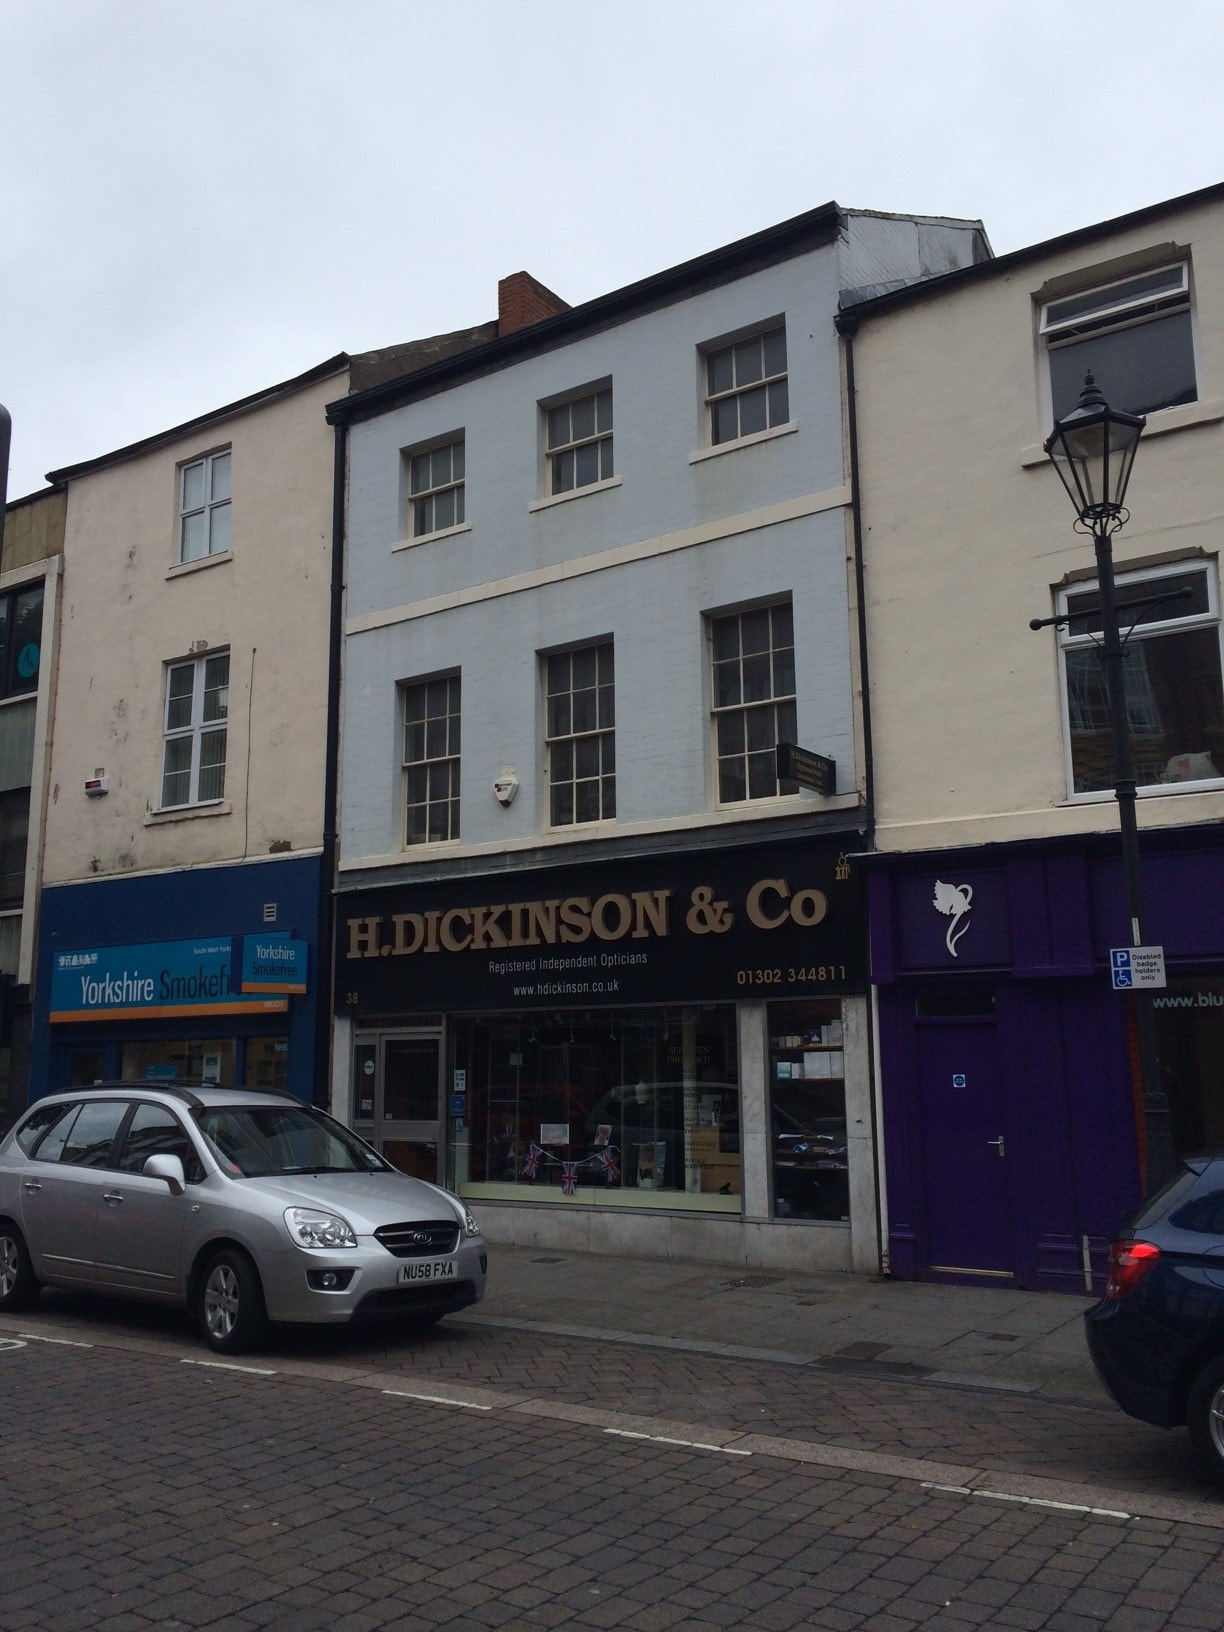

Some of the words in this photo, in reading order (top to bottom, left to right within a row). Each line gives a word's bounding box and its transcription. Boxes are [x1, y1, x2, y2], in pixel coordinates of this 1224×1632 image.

[346, 889, 672, 959] H.DICKINSON
[686, 886, 734, 935] &
[746, 878, 828, 930] Co
[256, 944, 296, 961] Yorkshire
[1116, 952, 1128, 967] P
[252, 961, 298, 977] Smokefree
[488, 960, 536, 975] Registered
[539, 956, 597, 972] Independent
[600, 951, 648, 967] Opticians
[737, 969, 782, 985] 01302
[787, 965, 847, 982] 344811
[81, 970, 154, 1005] Yorkshire
[159, 964, 232, 1001] Smokefr
[513, 978, 619, 996] www.hdickinson.co.uk
[346, 992, 359, 1005] 38
[274, 1044, 288, 1052] NHS
[667, 1056, 711, 1064] PRODED
[403, 1264, 432, 1280] NU58
[434, 1262, 453, 1277] FXA
